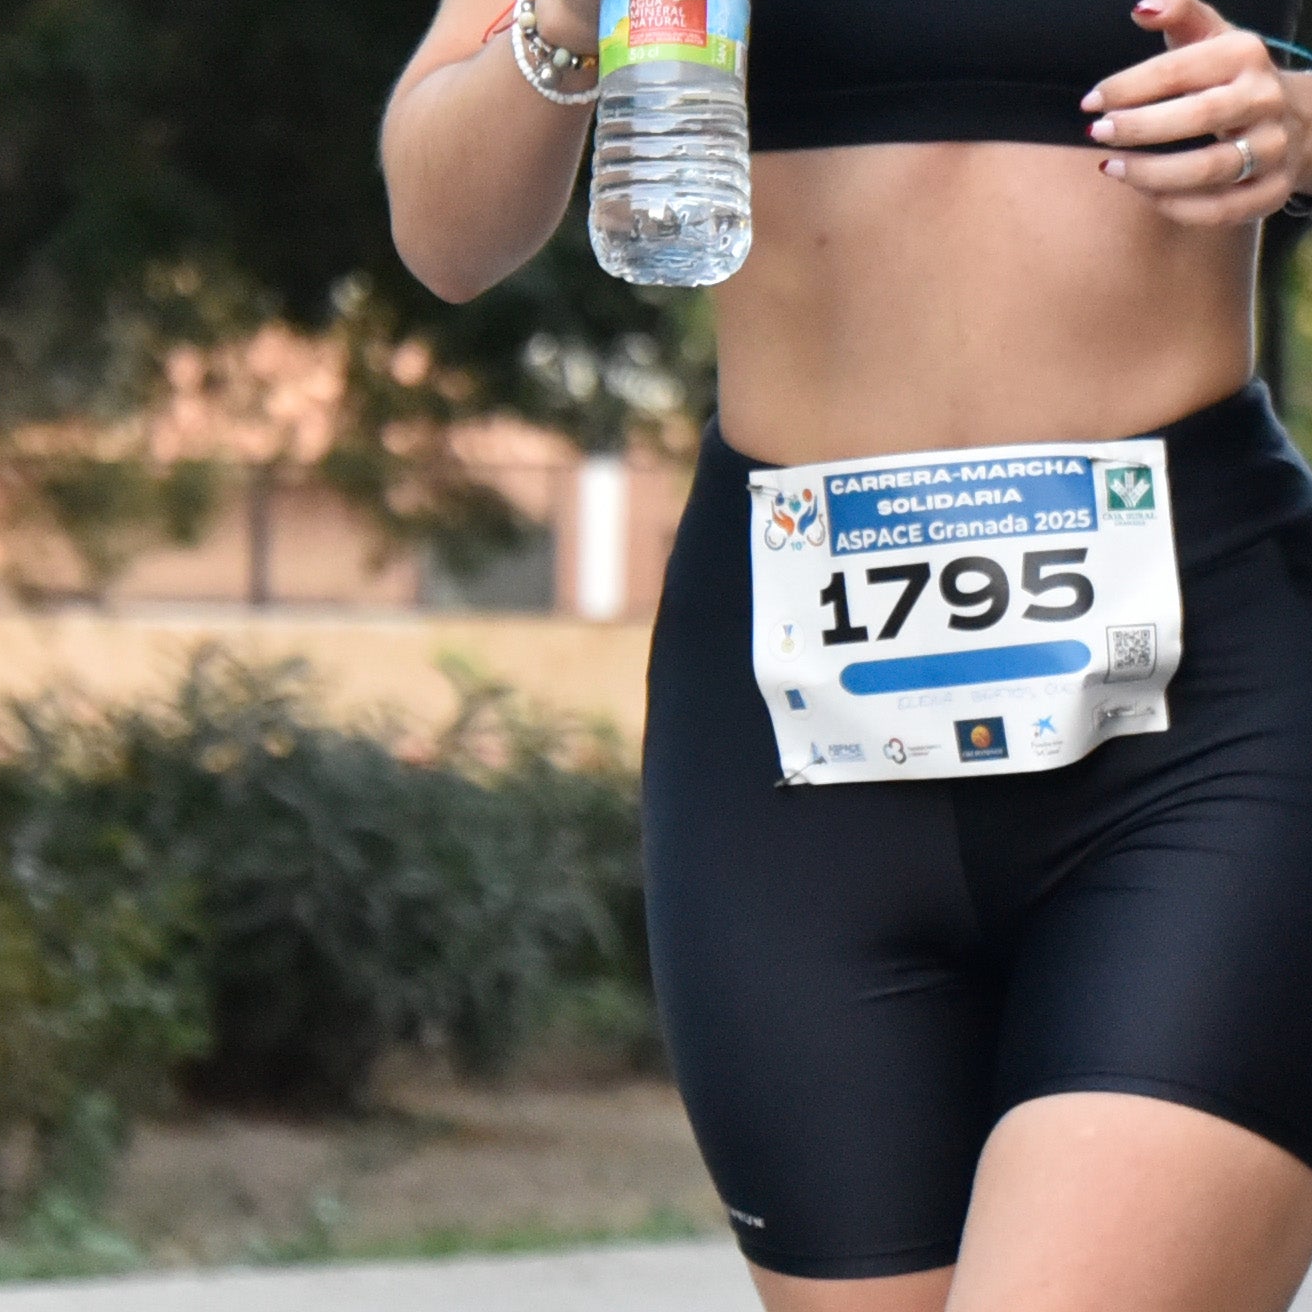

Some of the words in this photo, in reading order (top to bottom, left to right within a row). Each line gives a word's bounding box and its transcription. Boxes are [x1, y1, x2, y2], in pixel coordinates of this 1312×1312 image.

[630, 6, 686, 18] MINERAL
[630, 17, 686, 29] NATURAL
[630, 49, 645, 61] 50
[648, 47, 659, 58] cl
[830, 460, 1085, 495] CARRERA-MARCHA
[876, 488, 1023, 516] SOLIDARIA
[835, 523, 923, 551] ASPACE
[928, 514, 1029, 541] Granada
[1034, 509, 1091, 531] 2025
[820, 547, 1095, 646] 1795
